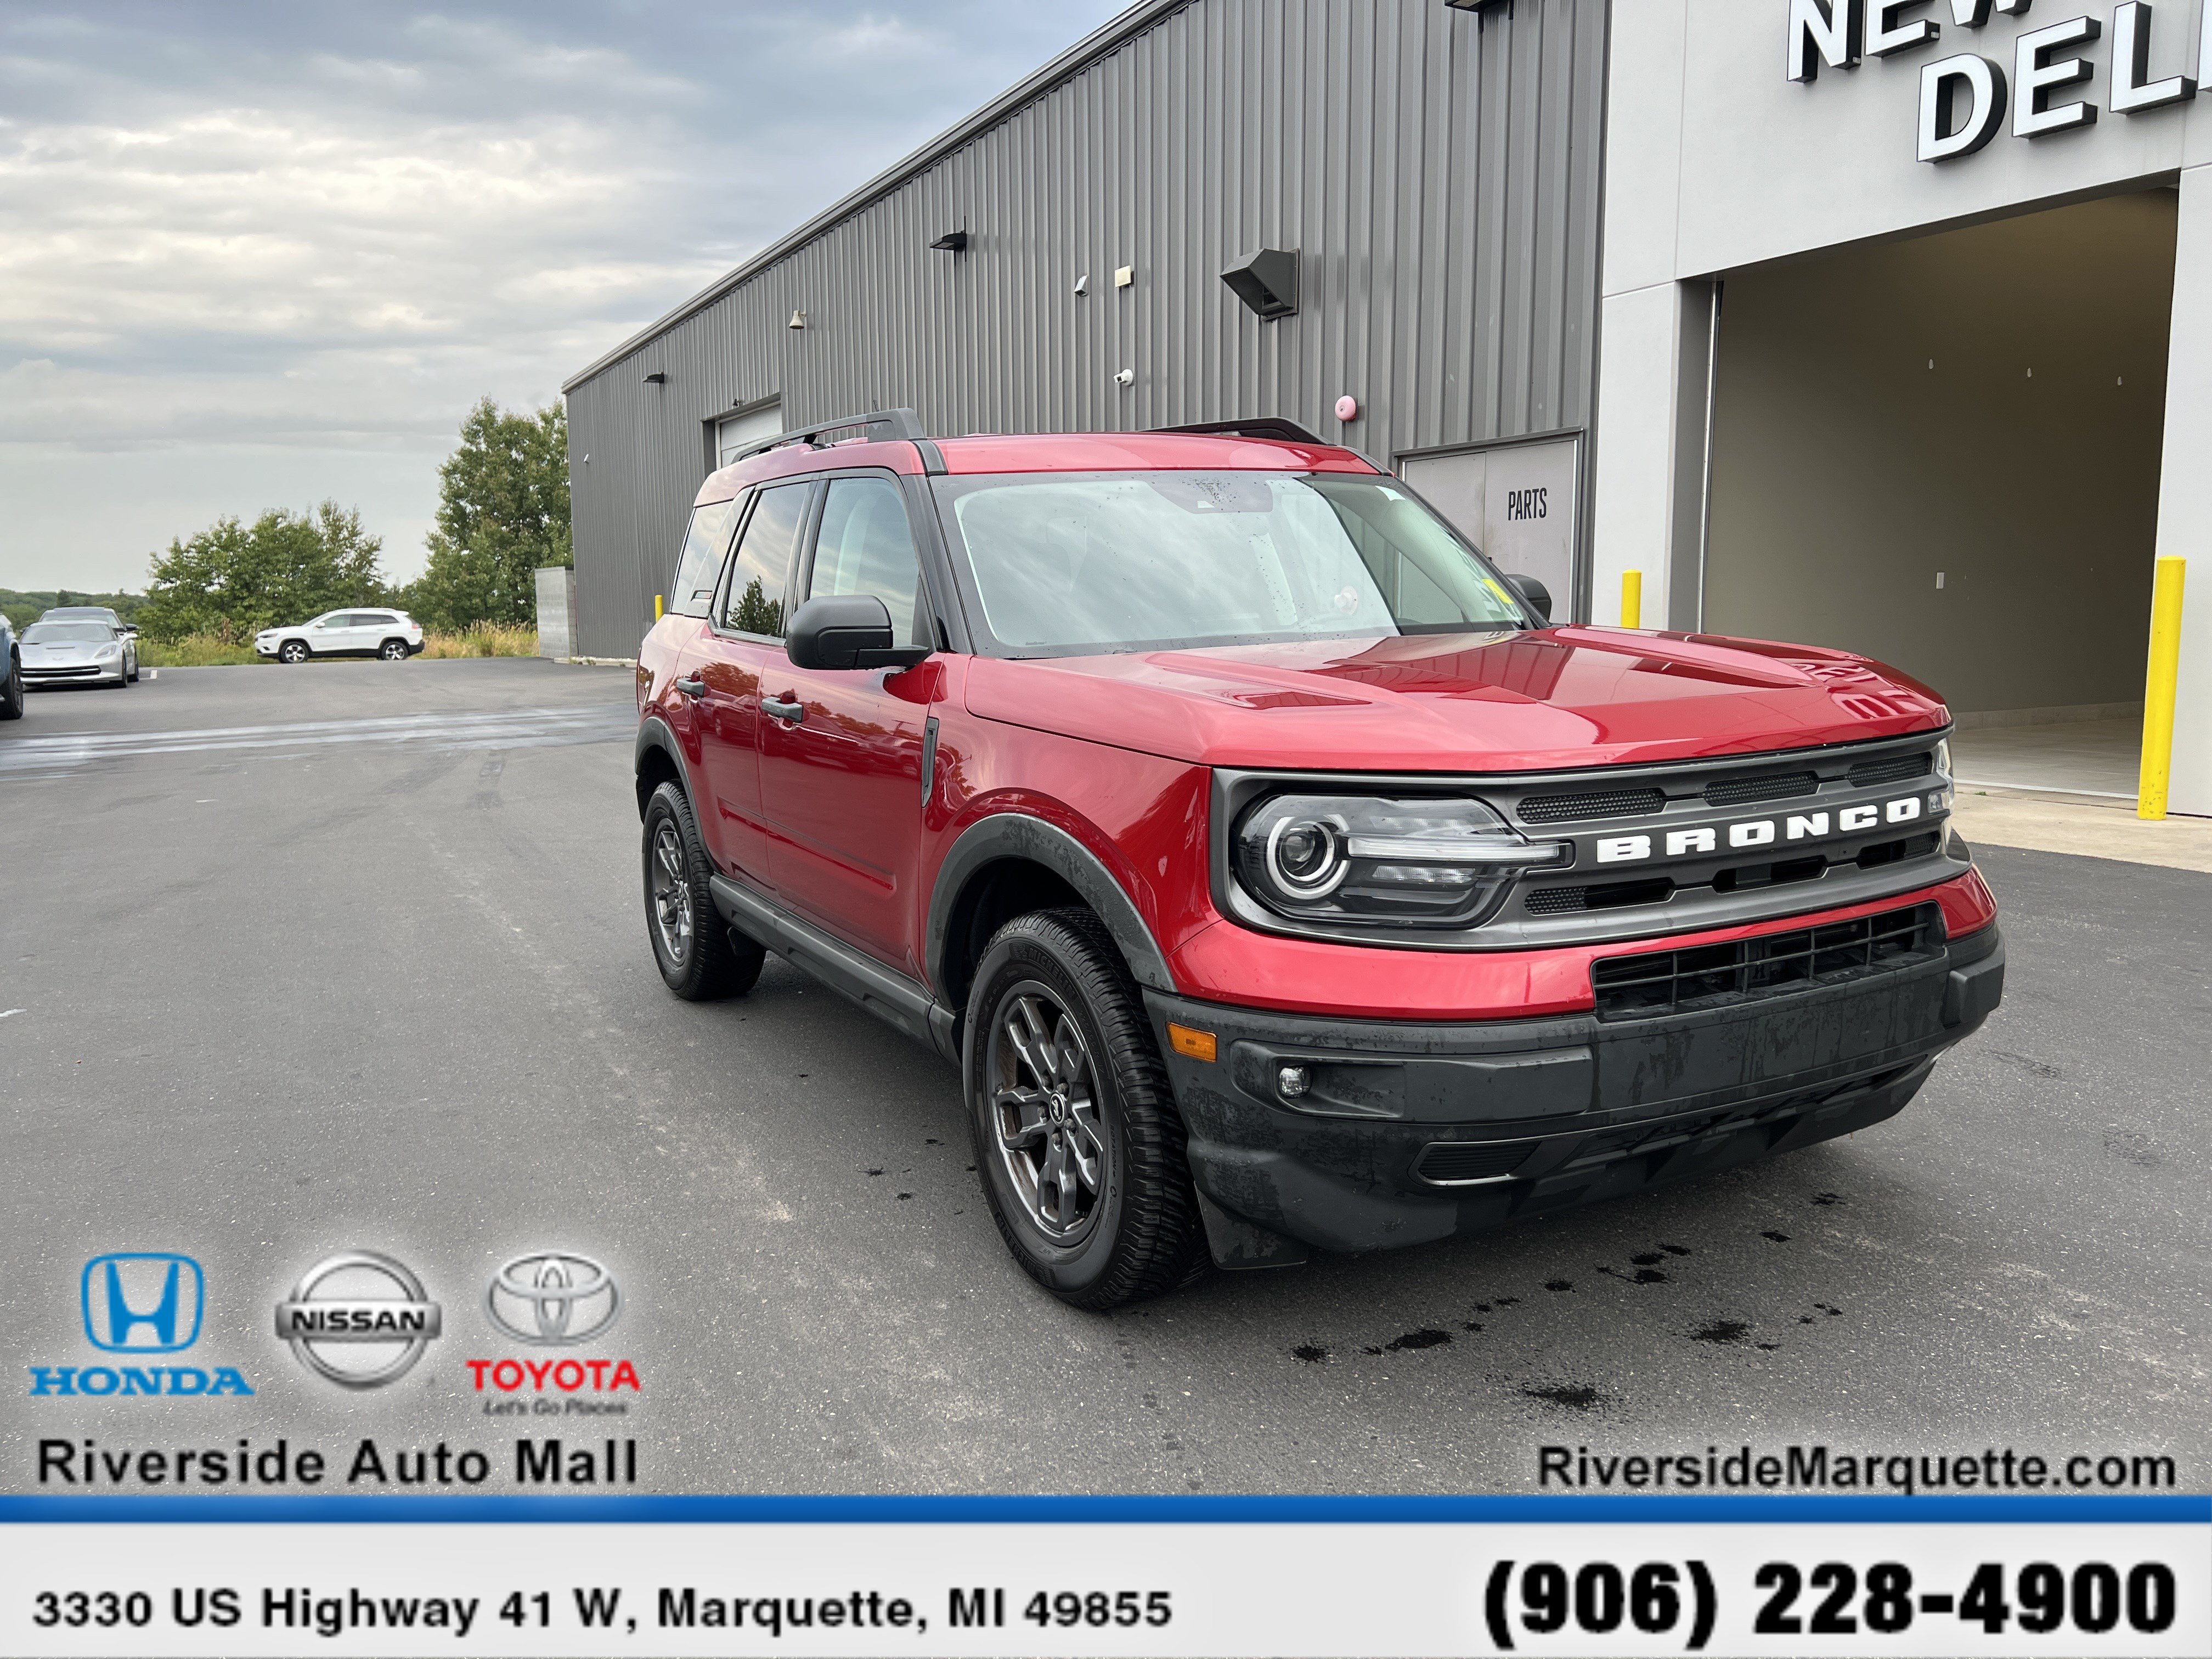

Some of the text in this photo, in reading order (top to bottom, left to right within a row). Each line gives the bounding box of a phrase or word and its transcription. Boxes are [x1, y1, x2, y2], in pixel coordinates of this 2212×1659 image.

[1787, 0, 2032, 83] NE
[1916, 0, 2212, 163] DEL
[1508, 487, 1548, 521] PARTS
[1596, 796, 1922, 864] BRONCO
[1028, 947, 1079, 1003] MICHELIN
